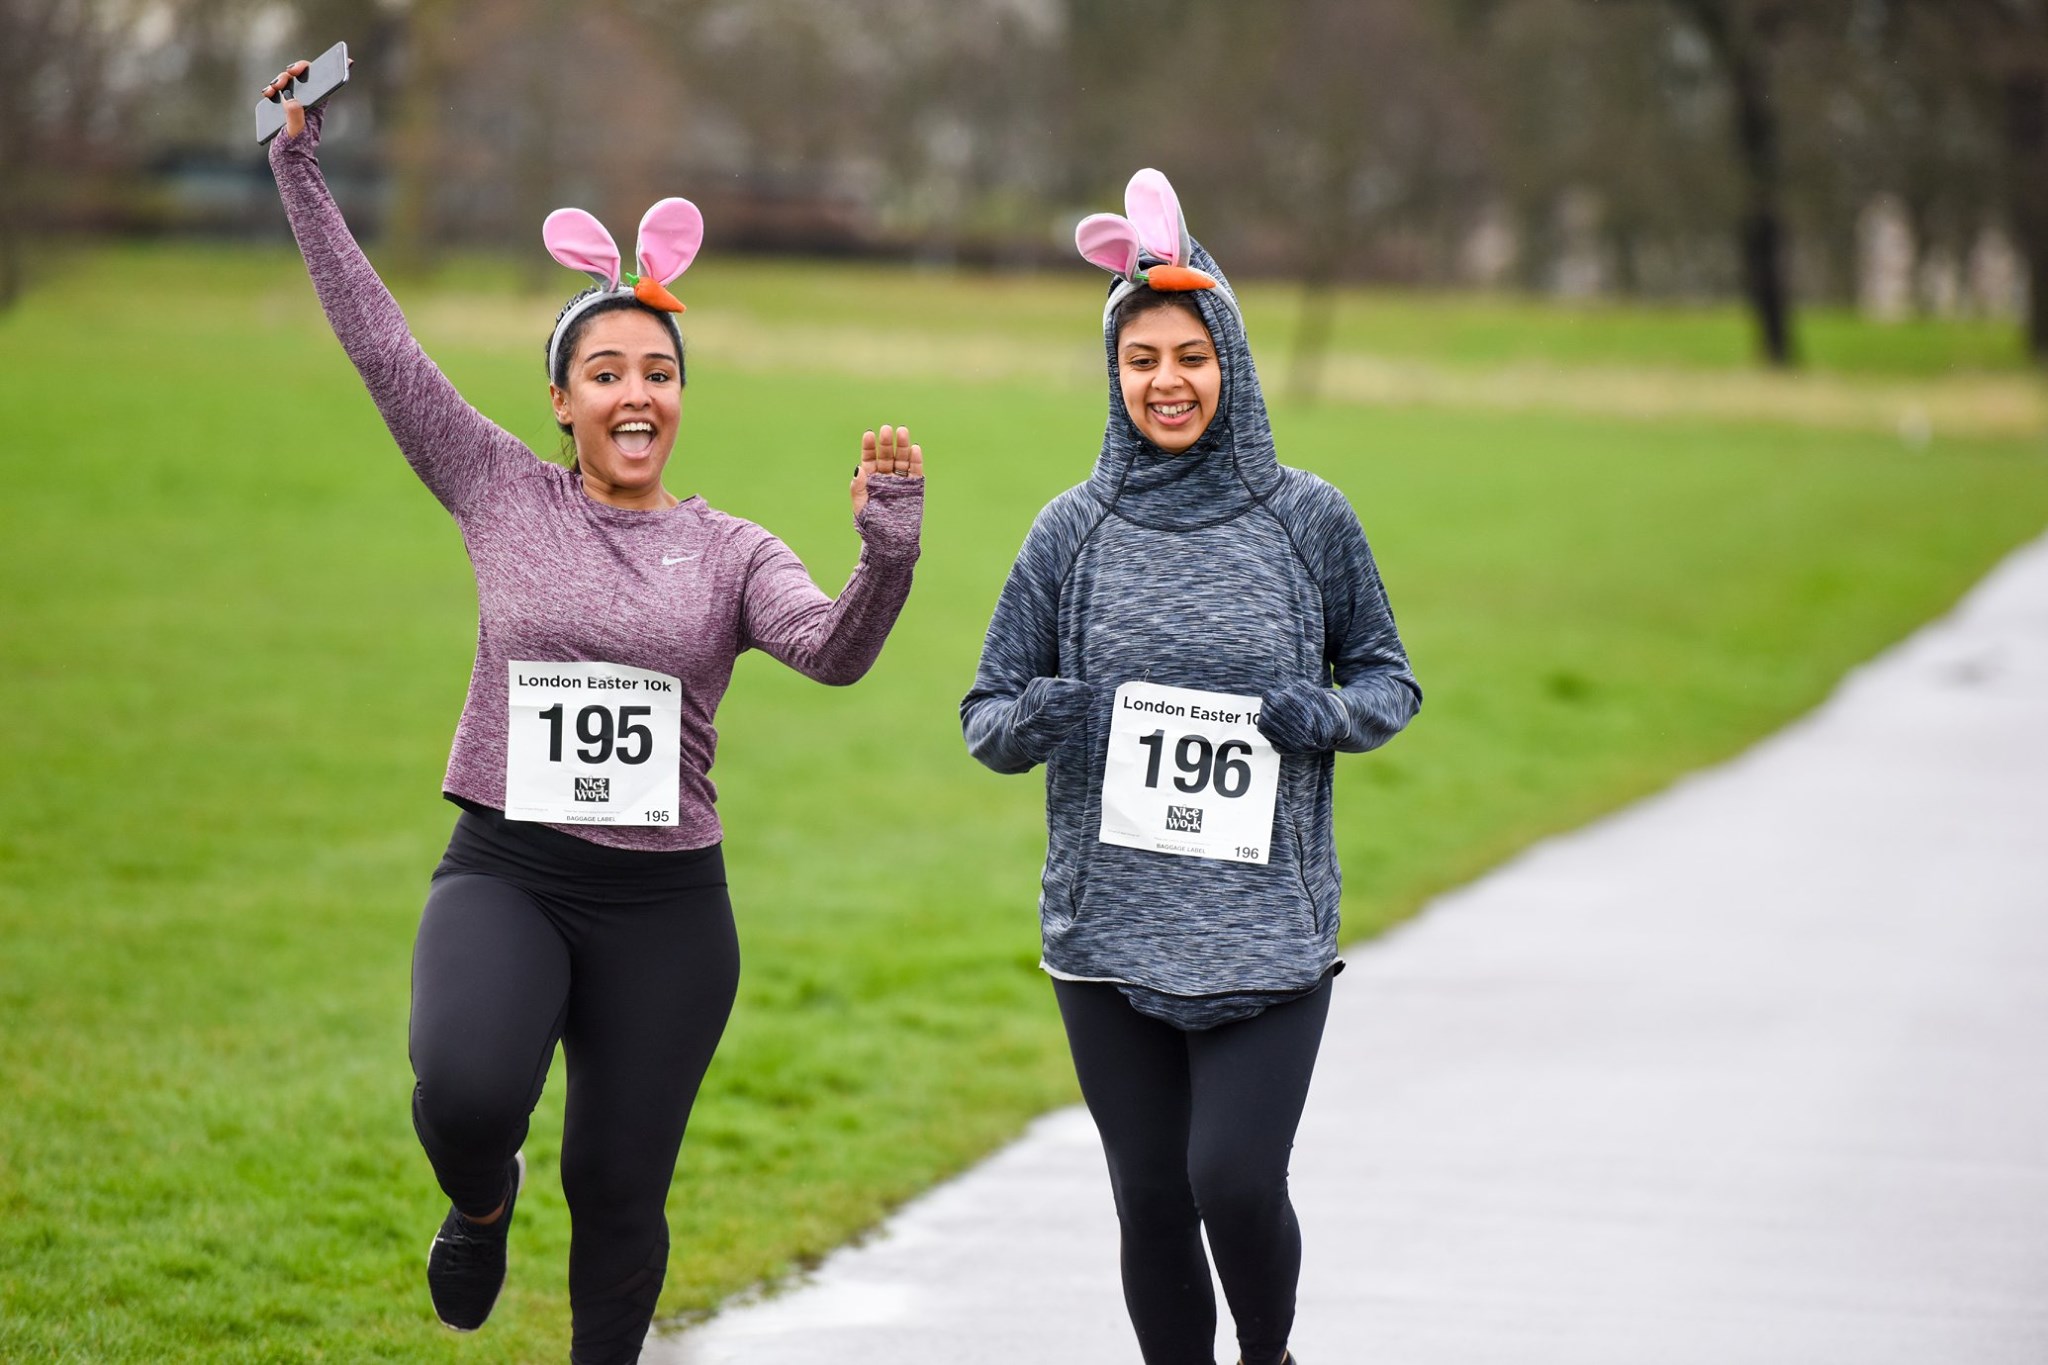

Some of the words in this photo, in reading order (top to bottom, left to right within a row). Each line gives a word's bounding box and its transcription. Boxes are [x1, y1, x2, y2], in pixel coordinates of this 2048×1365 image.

[518, 674, 581, 688] London
[587, 676, 638, 690] Easter
[644, 679, 672, 692] 10k
[1123, 696, 1185, 716] London
[1190, 706, 1241, 723] Easter
[1245, 712, 1261, 726] 10
[539, 703, 653, 765] 195
[1139, 729, 1253, 798] 196
[579, 776, 606, 791] Nice
[576, 787, 609, 802] Work
[644, 810, 670, 822] 195
[1171, 805, 1199, 821] Nice
[1167, 817, 1201, 832] Work
[1156, 844, 1185, 852] BAGGAGE
[1187, 846, 1206, 854] LABEL
[1234, 847, 1259, 859] 196
